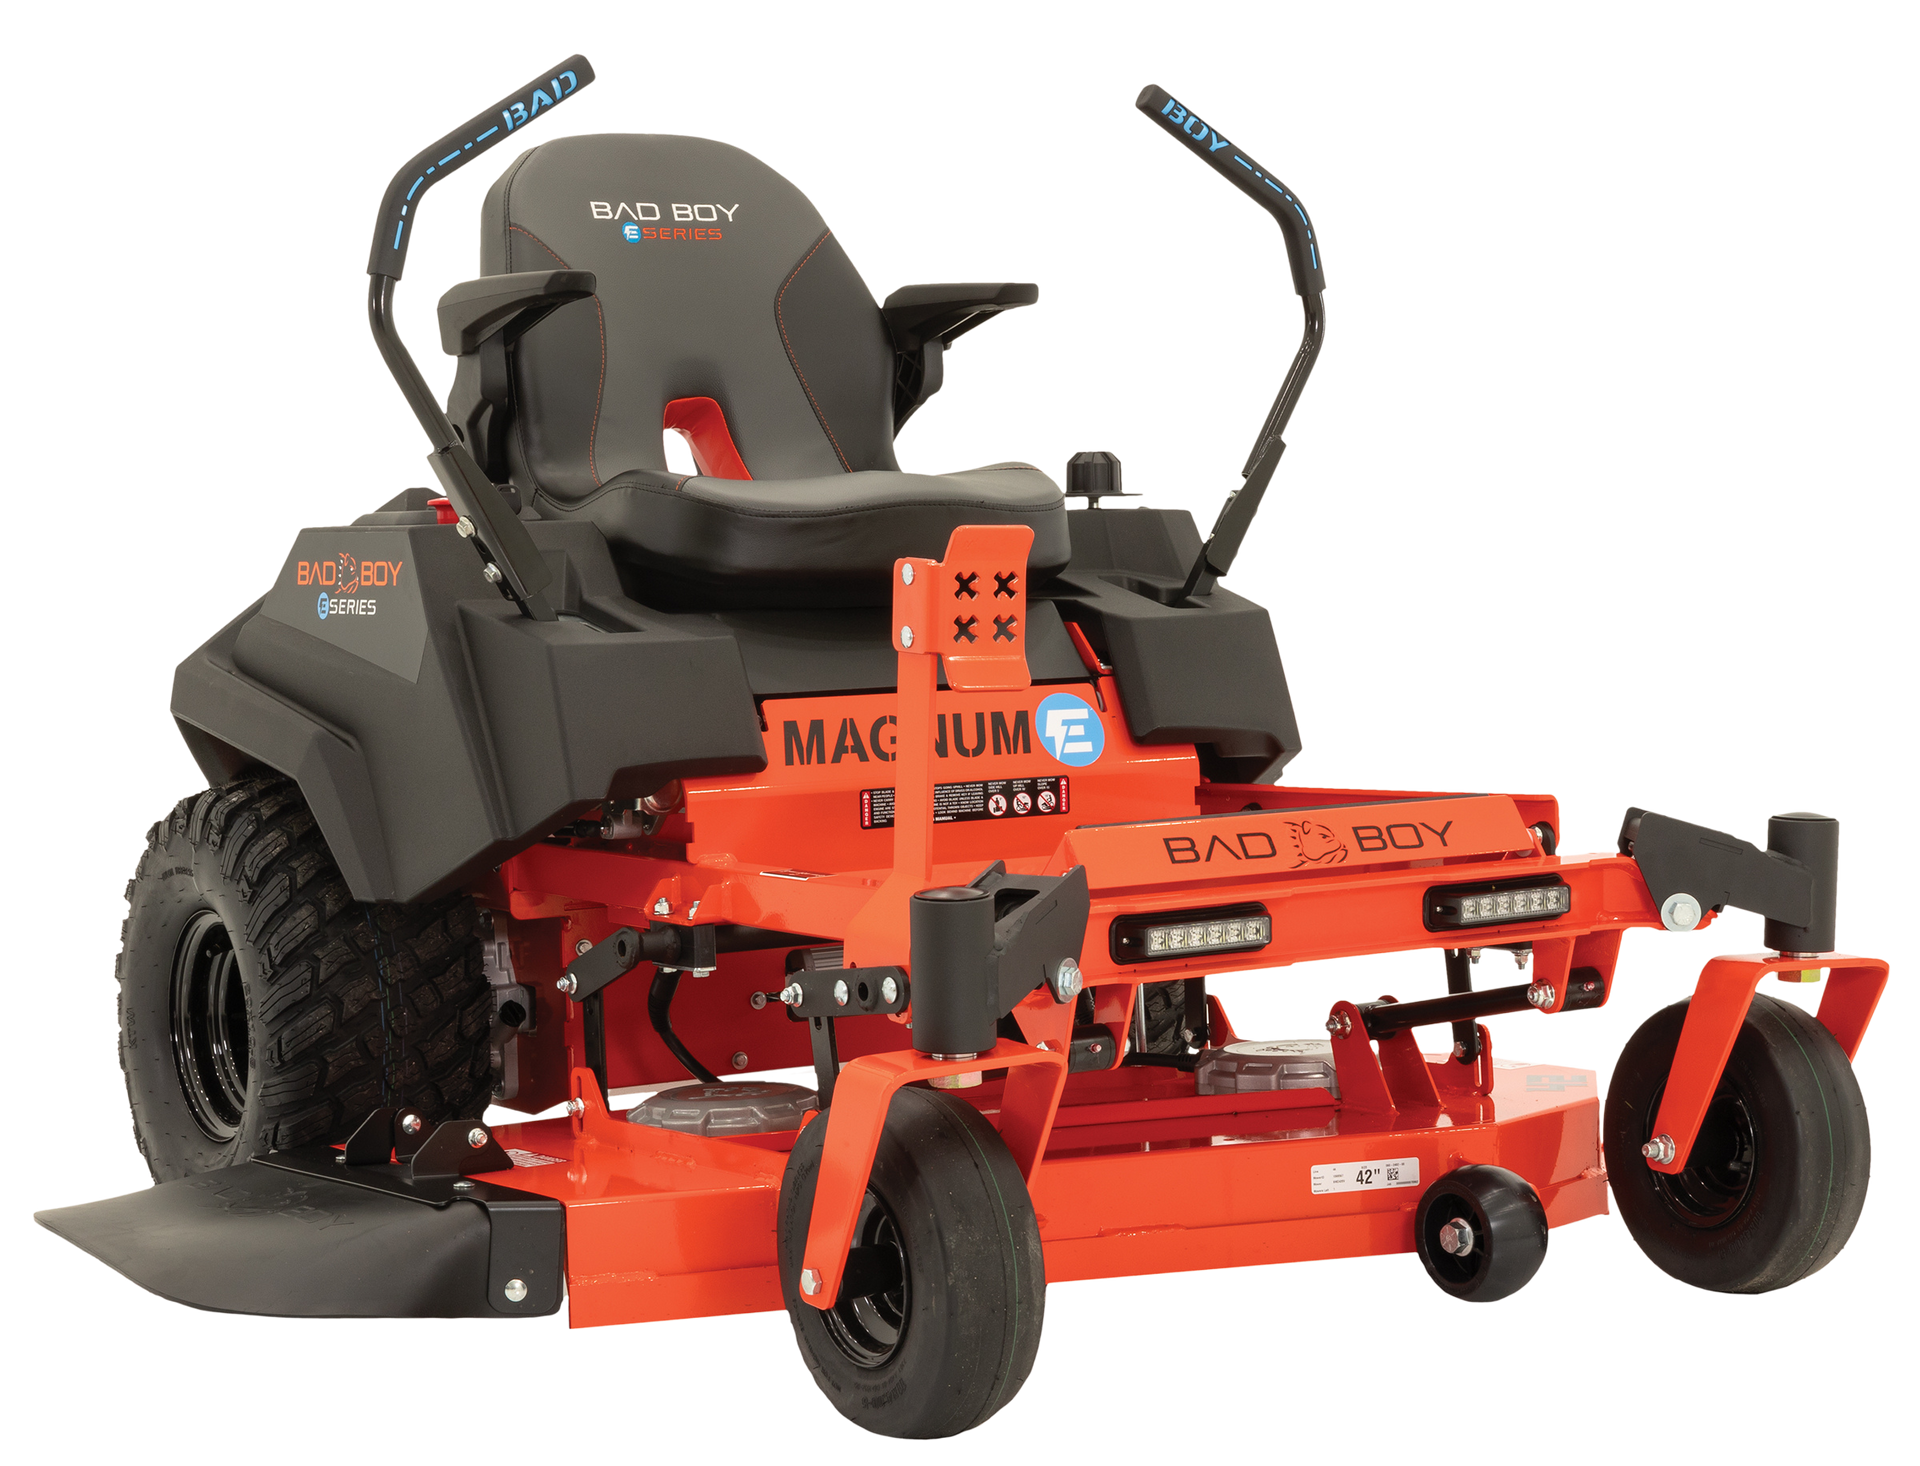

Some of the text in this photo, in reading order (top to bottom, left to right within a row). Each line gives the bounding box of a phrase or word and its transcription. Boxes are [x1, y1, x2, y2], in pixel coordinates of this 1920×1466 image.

[502, 70, 578, 132] BAD
[1161, 98, 1230, 152] BOY
[590, 201, 739, 222] BAD BOY
[642, 227, 722, 240] SERIES
[297, 561, 403, 586] BAD BOY
[329, 599, 377, 615] SERIES
[1163, 821, 1453, 864] BAD BOY
[1355, 1168, 1380, 1185] 42"
